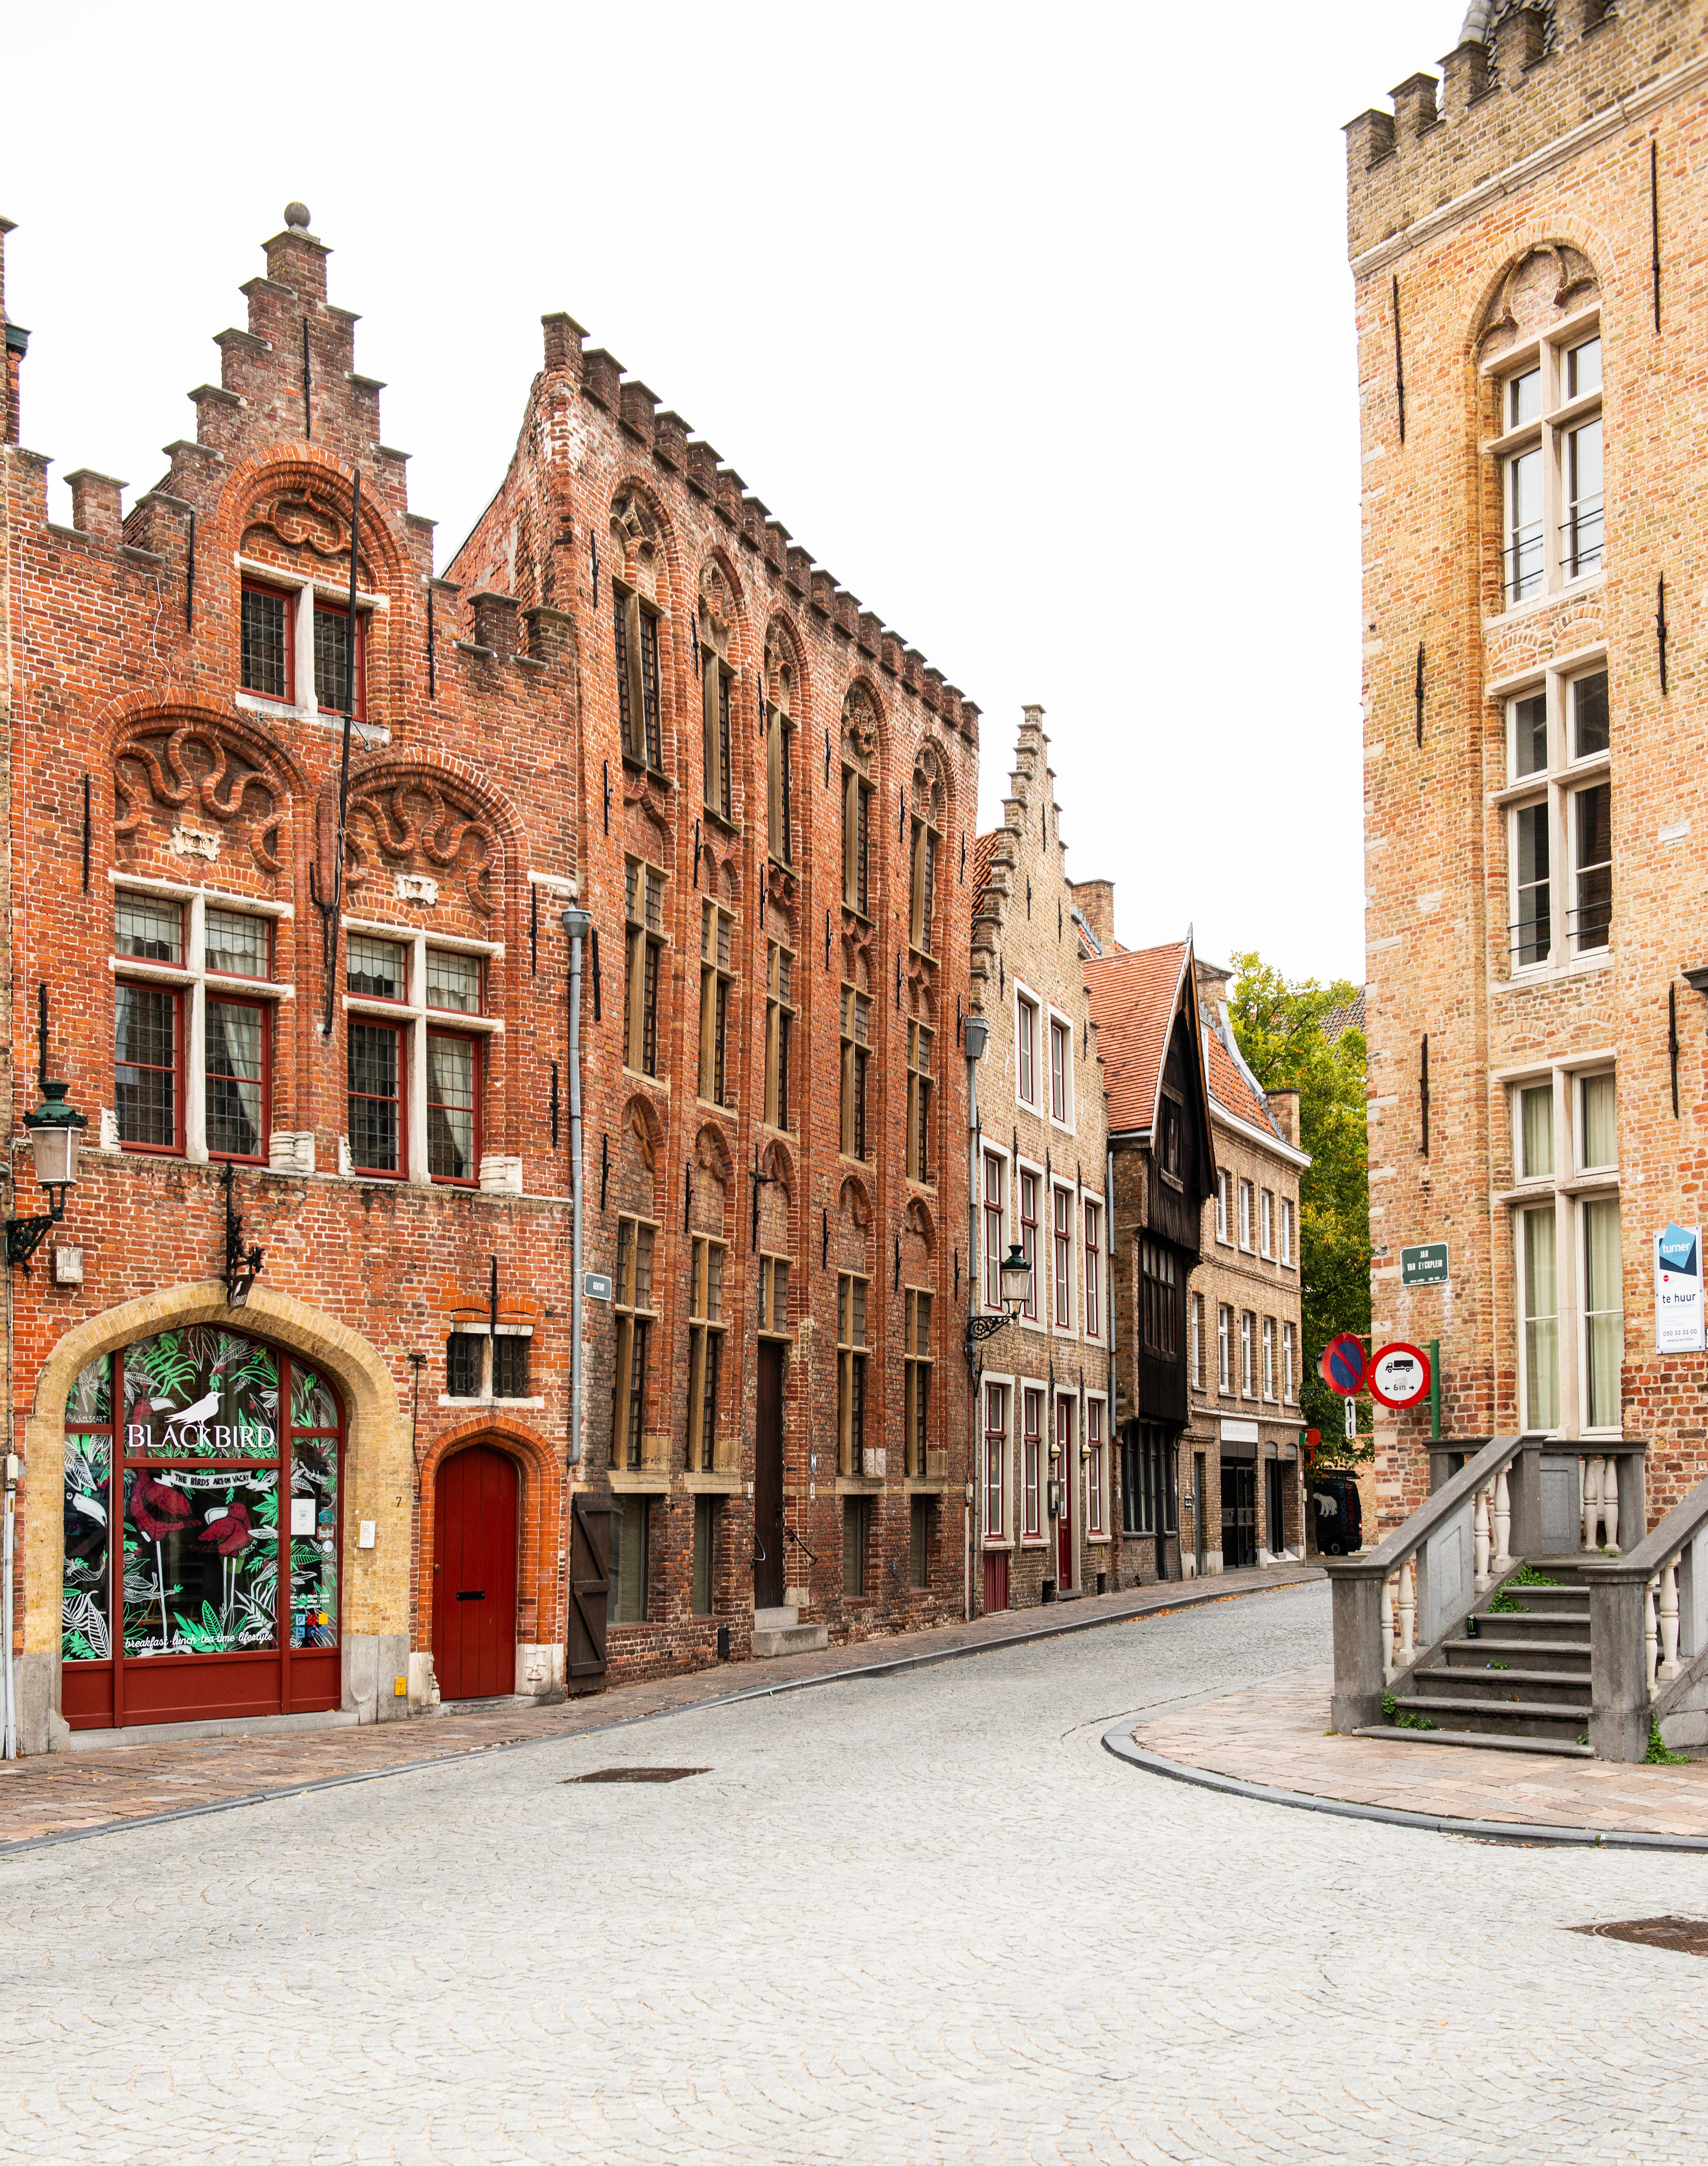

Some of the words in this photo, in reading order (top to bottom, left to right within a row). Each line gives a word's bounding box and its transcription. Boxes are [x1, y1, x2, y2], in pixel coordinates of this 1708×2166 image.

[1662, 1243, 1691, 1254] turner
[1420, 1250, 1429, 1259] JAN
[1407, 1263, 1416, 1271] VAN
[1418, 1260, 1442, 1270] EYCKPLEIN
[1662, 1295, 1671, 1303] te
[1675, 1293, 1696, 1302] huur
[127, 1424, 274, 1449] BLACKBIRD
[174, 1474, 187, 1484] THE
[190, 1477, 209, 1486] BIRDS
[232, 1475, 250, 1483] VACAY
[396, 1497, 402, 1507] 7
[1338, 1482, 1347, 1524] COOLING
[1345, 1482, 1354, 1525] HEATING
[125, 1636, 169, 1650] breakfast
[172, 1634, 197, 1646] lunch
[238, 1631, 274, 1645] lifestyle
